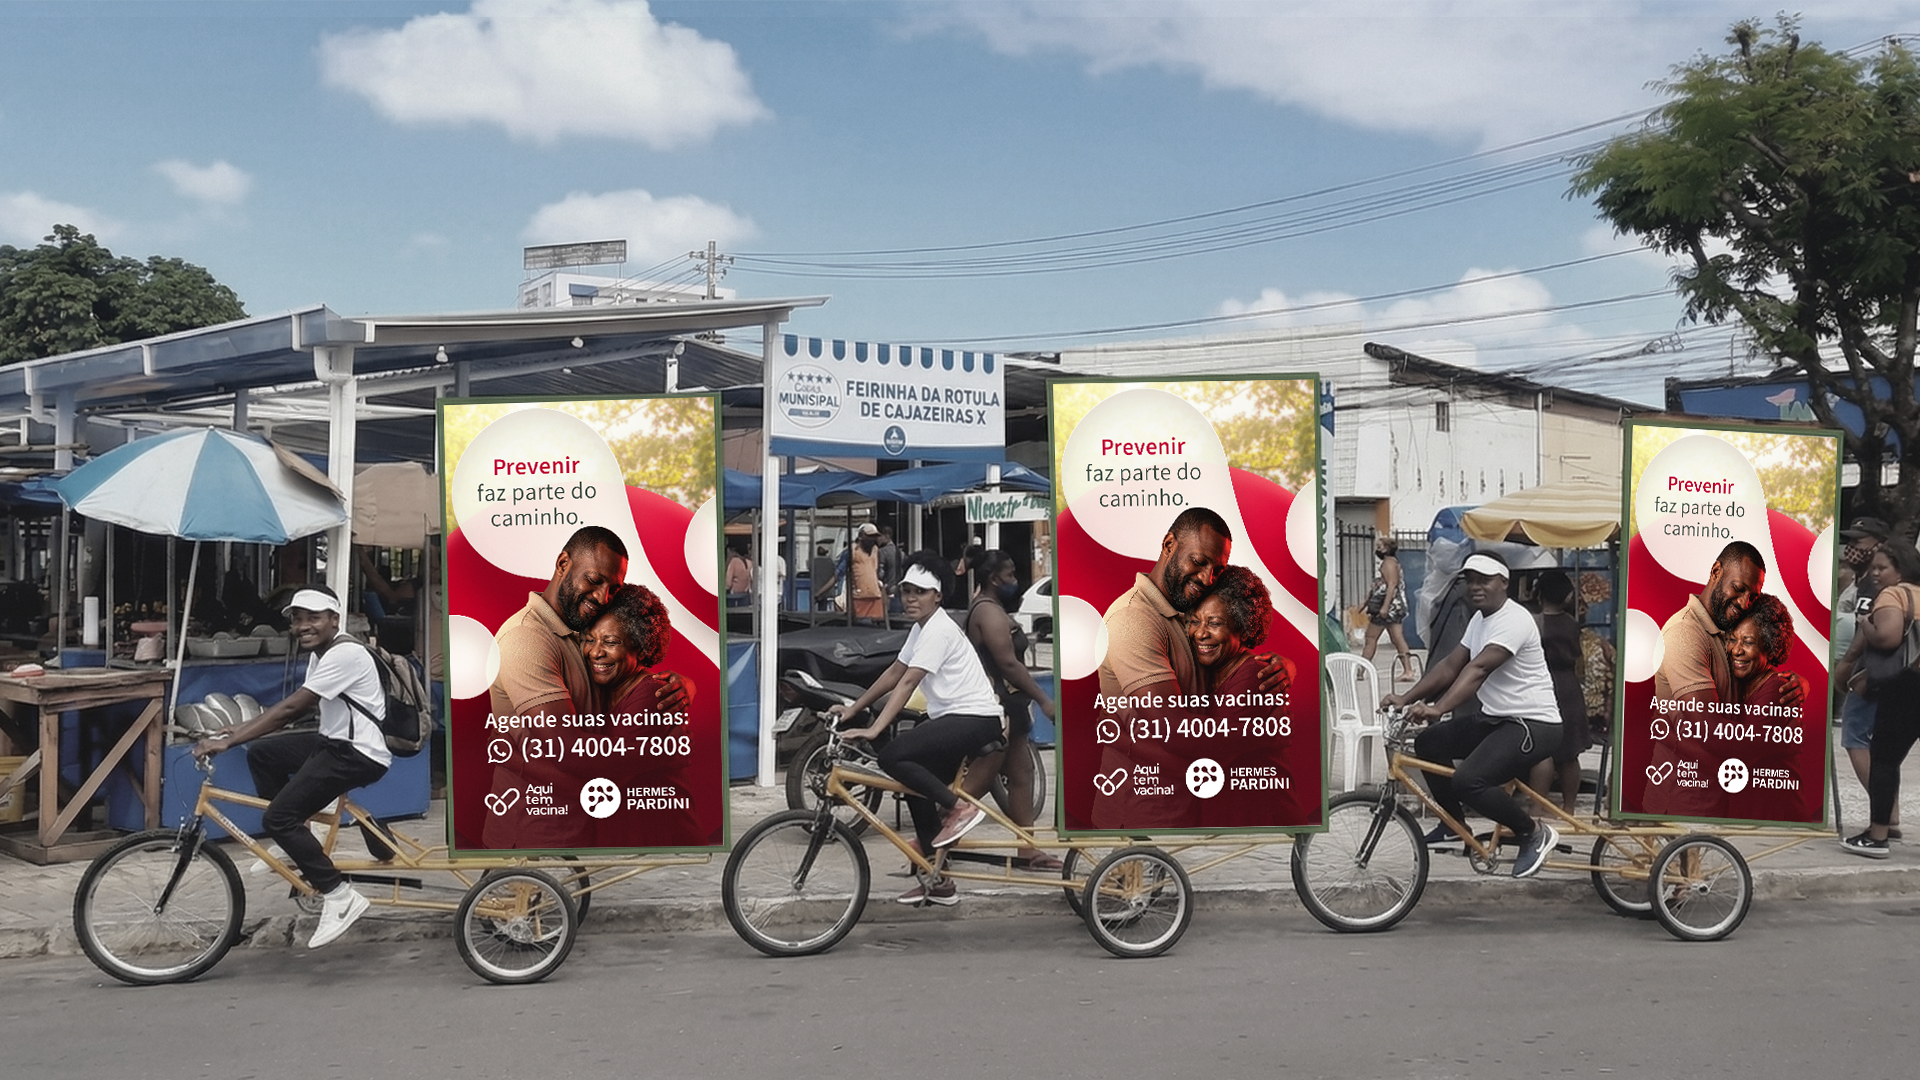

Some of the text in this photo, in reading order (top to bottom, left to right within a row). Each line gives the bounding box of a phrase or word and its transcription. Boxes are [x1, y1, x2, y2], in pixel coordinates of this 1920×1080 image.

[846, 380, 1000, 407] FEIRINHA DA ROTULA
[860, 401, 986, 425] DE CAJAZEIRAS X
[1102, 437, 1186, 455] Prevenir
[494, 456, 580, 475] Prevenir
[1086, 462, 1201, 486] faz parte do
[478, 481, 597, 505] faz parte do
[1668, 476, 1734, 494] Prevenir
[1099, 488, 1189, 507] caminho.
[1655, 496, 1745, 518] faz parte do
[491, 507, 584, 527] caminho.
[1664, 522, 1734, 539] caminho.
[1093, 690, 1290, 714] Agende suas vacinas:
[1649, 695, 1803, 718] Agende suas vacinas:
[484, 709, 689, 733] Agende suas vacinas:
[1129, 716, 1292, 743] (31) 4004-7808
[1676, 718, 1803, 744] (31) 4004-7808
[521, 735, 691, 762] (31) 4004-7808
[1133, 763, 1160, 775] Aqui
[1230, 767, 1277, 777] HERMES
[1677, 759, 1699, 771] Aqui
[1752, 768, 1790, 778] HERMES
[1133, 775, 1160, 785] tem
[1677, 769, 1698, 779] tem
[525, 783, 553, 795] Aqui
[626, 787, 676, 797] HERMES
[1133, 785, 1175, 796] vacina!
[1230, 777, 1290, 790] PARDINI
[1676, 779, 1709, 789] vacina!
[1752, 777, 1800, 790] PARDINI
[526, 794, 553, 805] tem
[627, 798, 690, 810] PARDINI
[526, 805, 569, 816] vacina!
